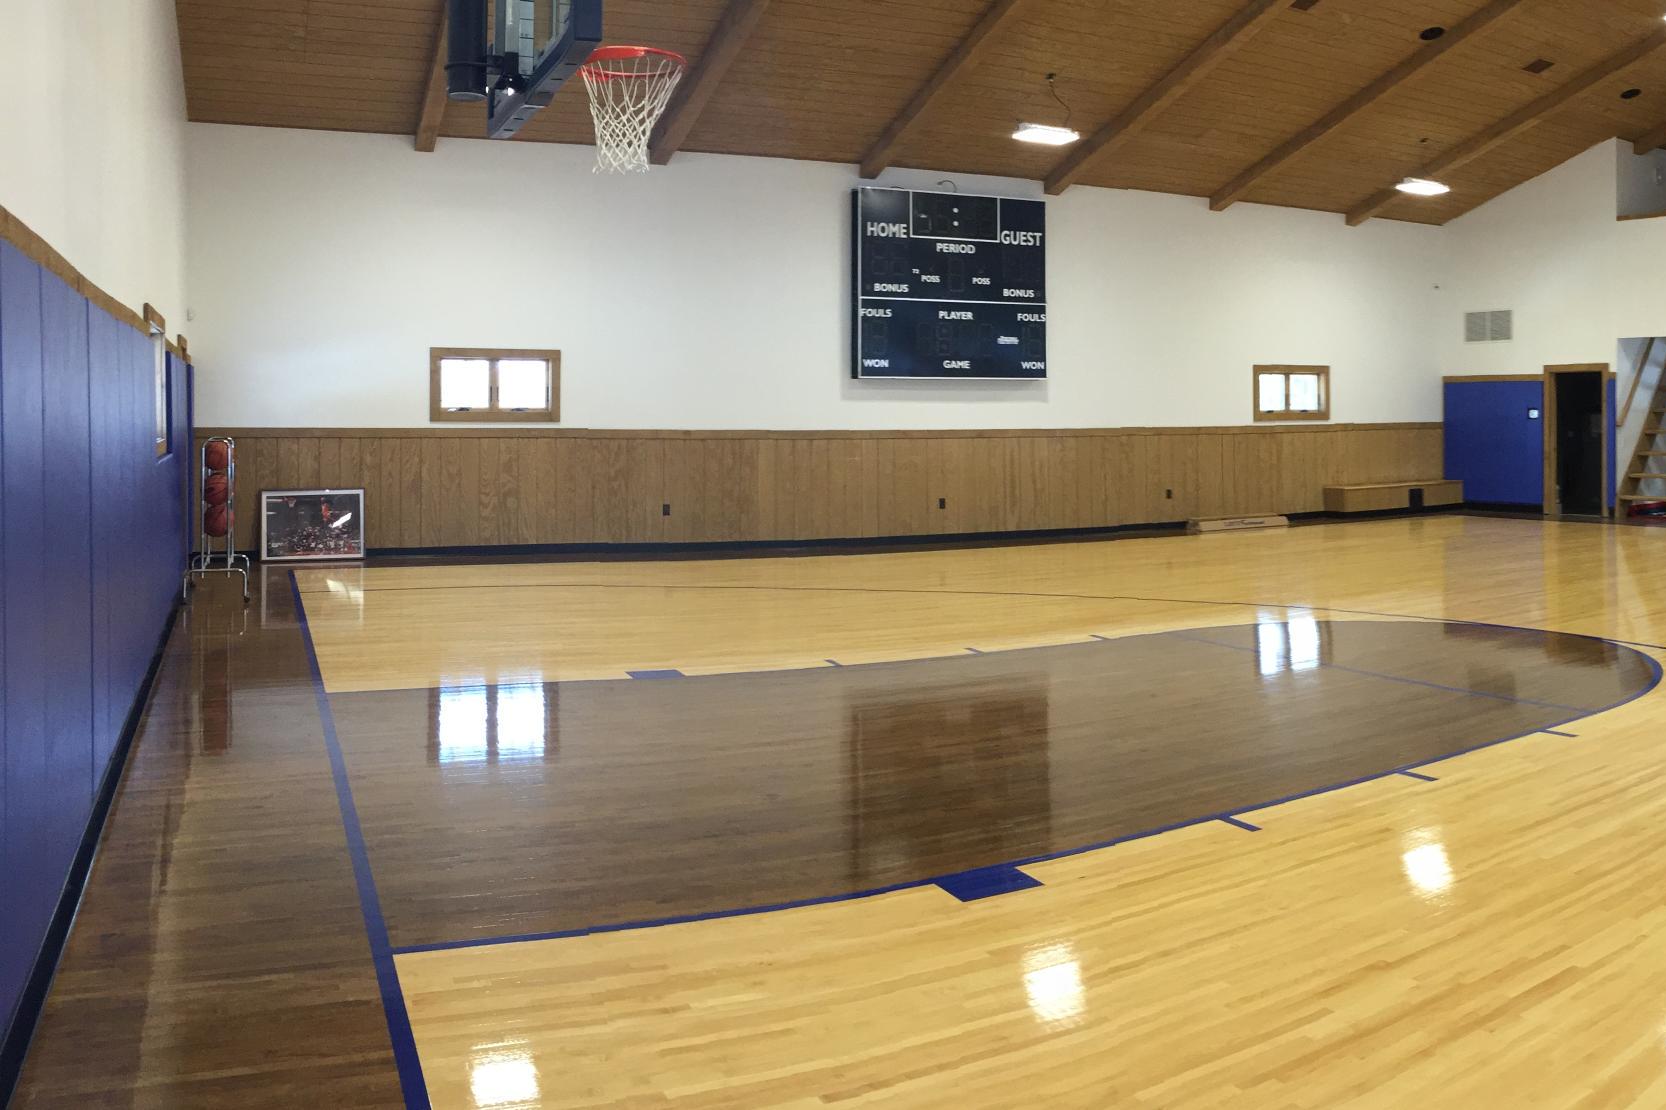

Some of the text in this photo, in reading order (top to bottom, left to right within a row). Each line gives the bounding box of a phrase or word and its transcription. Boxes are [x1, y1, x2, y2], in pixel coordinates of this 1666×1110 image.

[866, 222, 908, 239] HOME
[1000, 230, 1042, 246] GUEST
[936, 243, 976, 254] PERIOD
[921, 275, 941, 283] POSS
[972, 277, 991, 286] POSS
[873, 283, 909, 293] BONUS
[1002, 288, 1035, 298] BONUS
[860, 308, 893, 318] FOULS
[938, 311, 974, 320] PLAYER
[1016, 313, 1047, 322] FOULS
[863, 359, 889, 368] WON
[943, 360, 971, 369] GAME
[1021, 361, 1045, 370] WON
